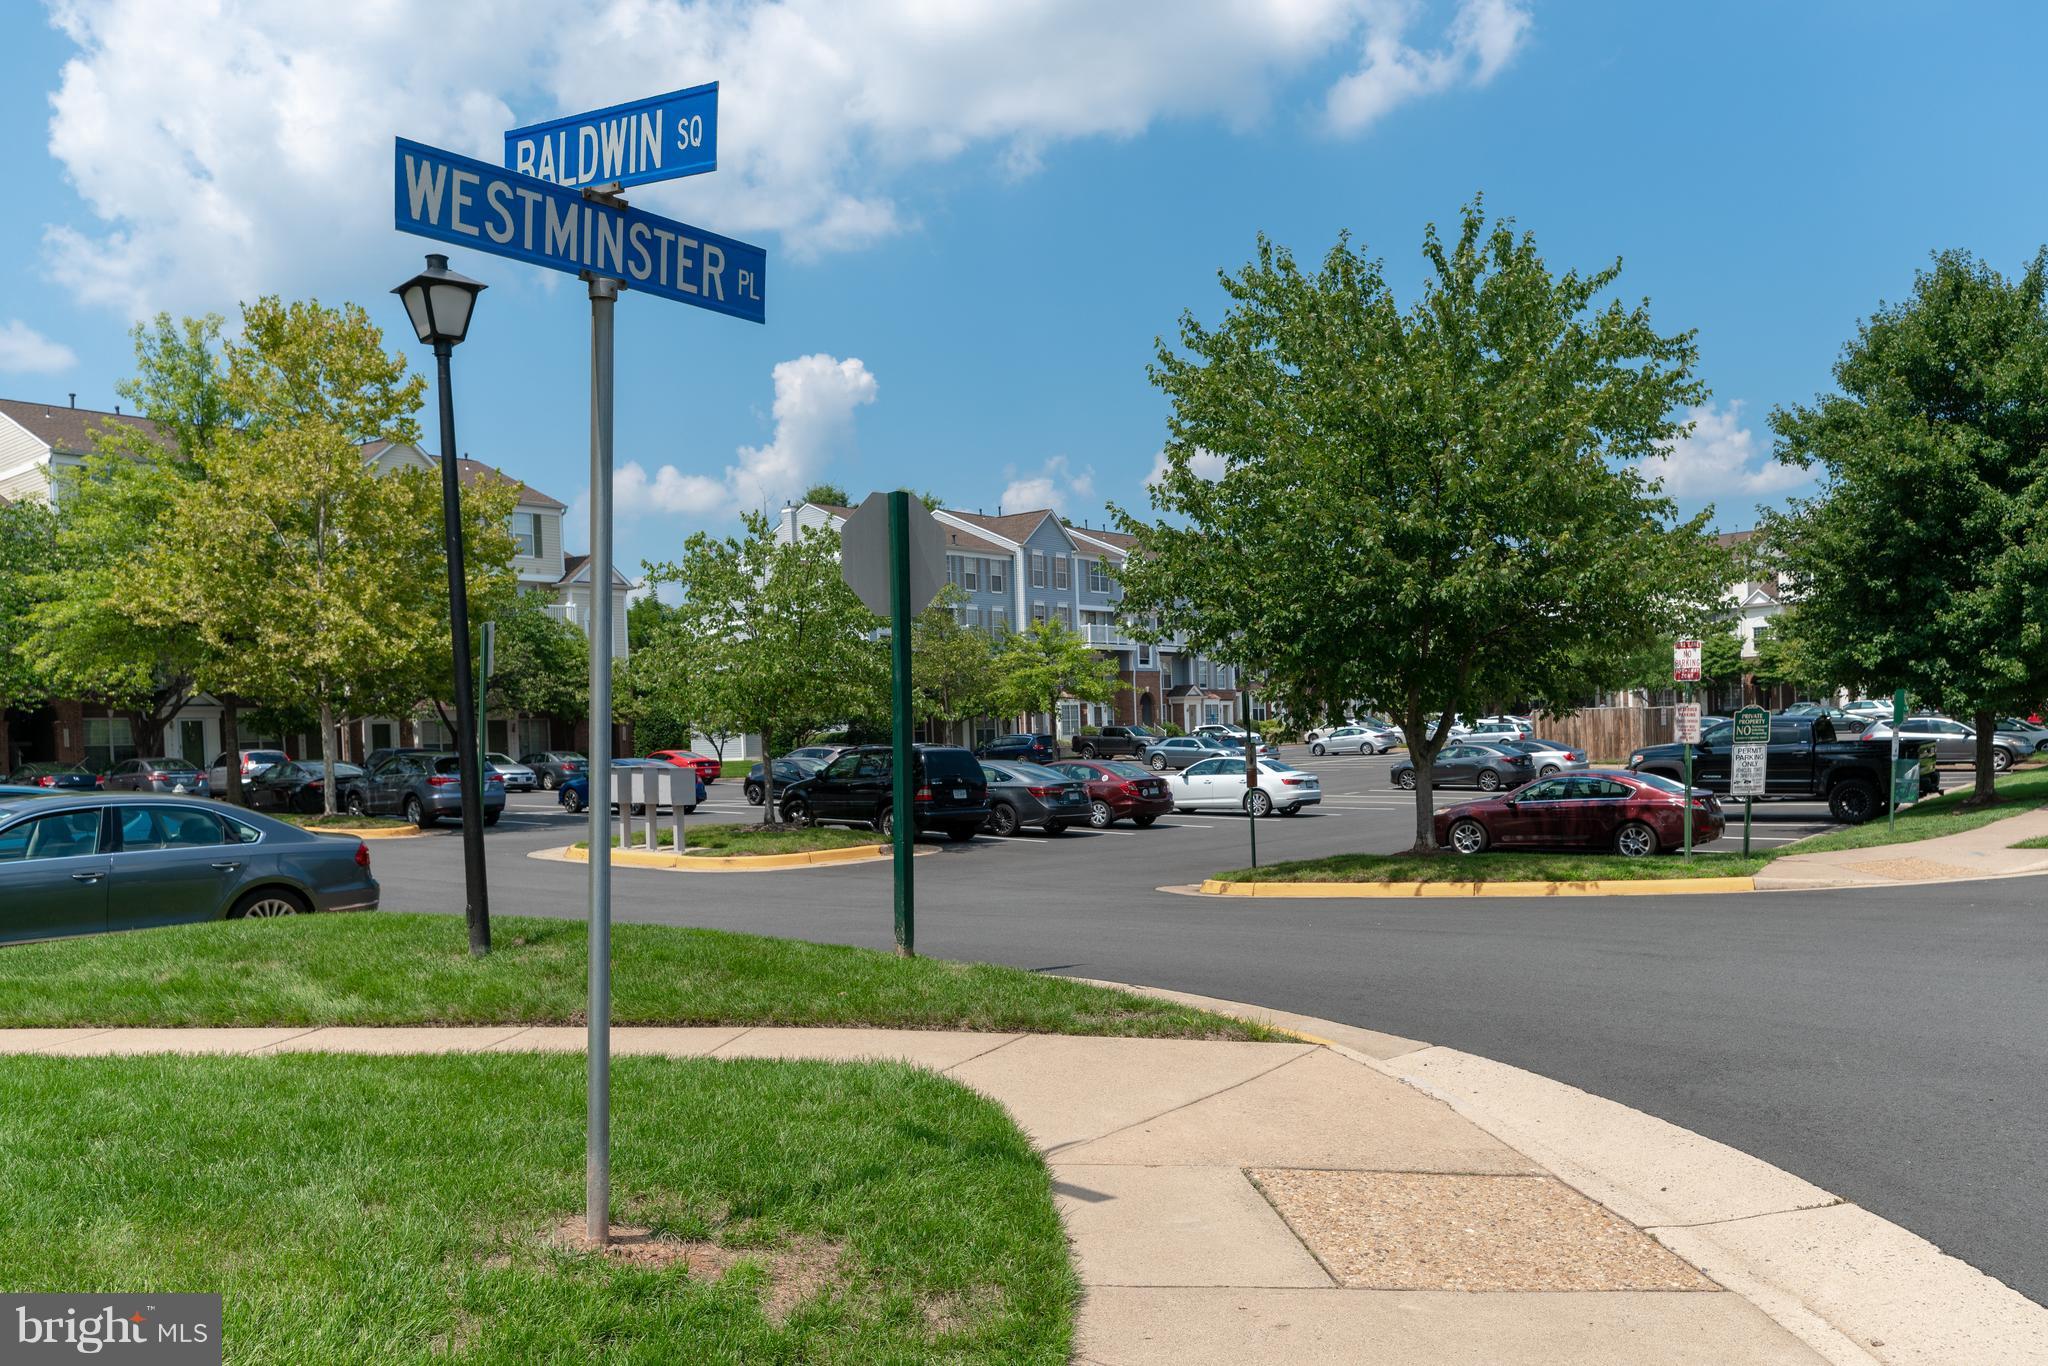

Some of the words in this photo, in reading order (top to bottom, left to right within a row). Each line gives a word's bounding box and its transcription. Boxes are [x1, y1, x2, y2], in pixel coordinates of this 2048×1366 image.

[516, 108, 663, 187] BALDWIN
[677, 114, 703, 151] SQ
[404, 154, 726, 302] WESTMINSTER
[738, 269, 761, 301] PL
[1683, 650, 1692, 658] NO
[1674, 659, 1701, 668] PARKING
[1736, 725, 1752, 736] NO
